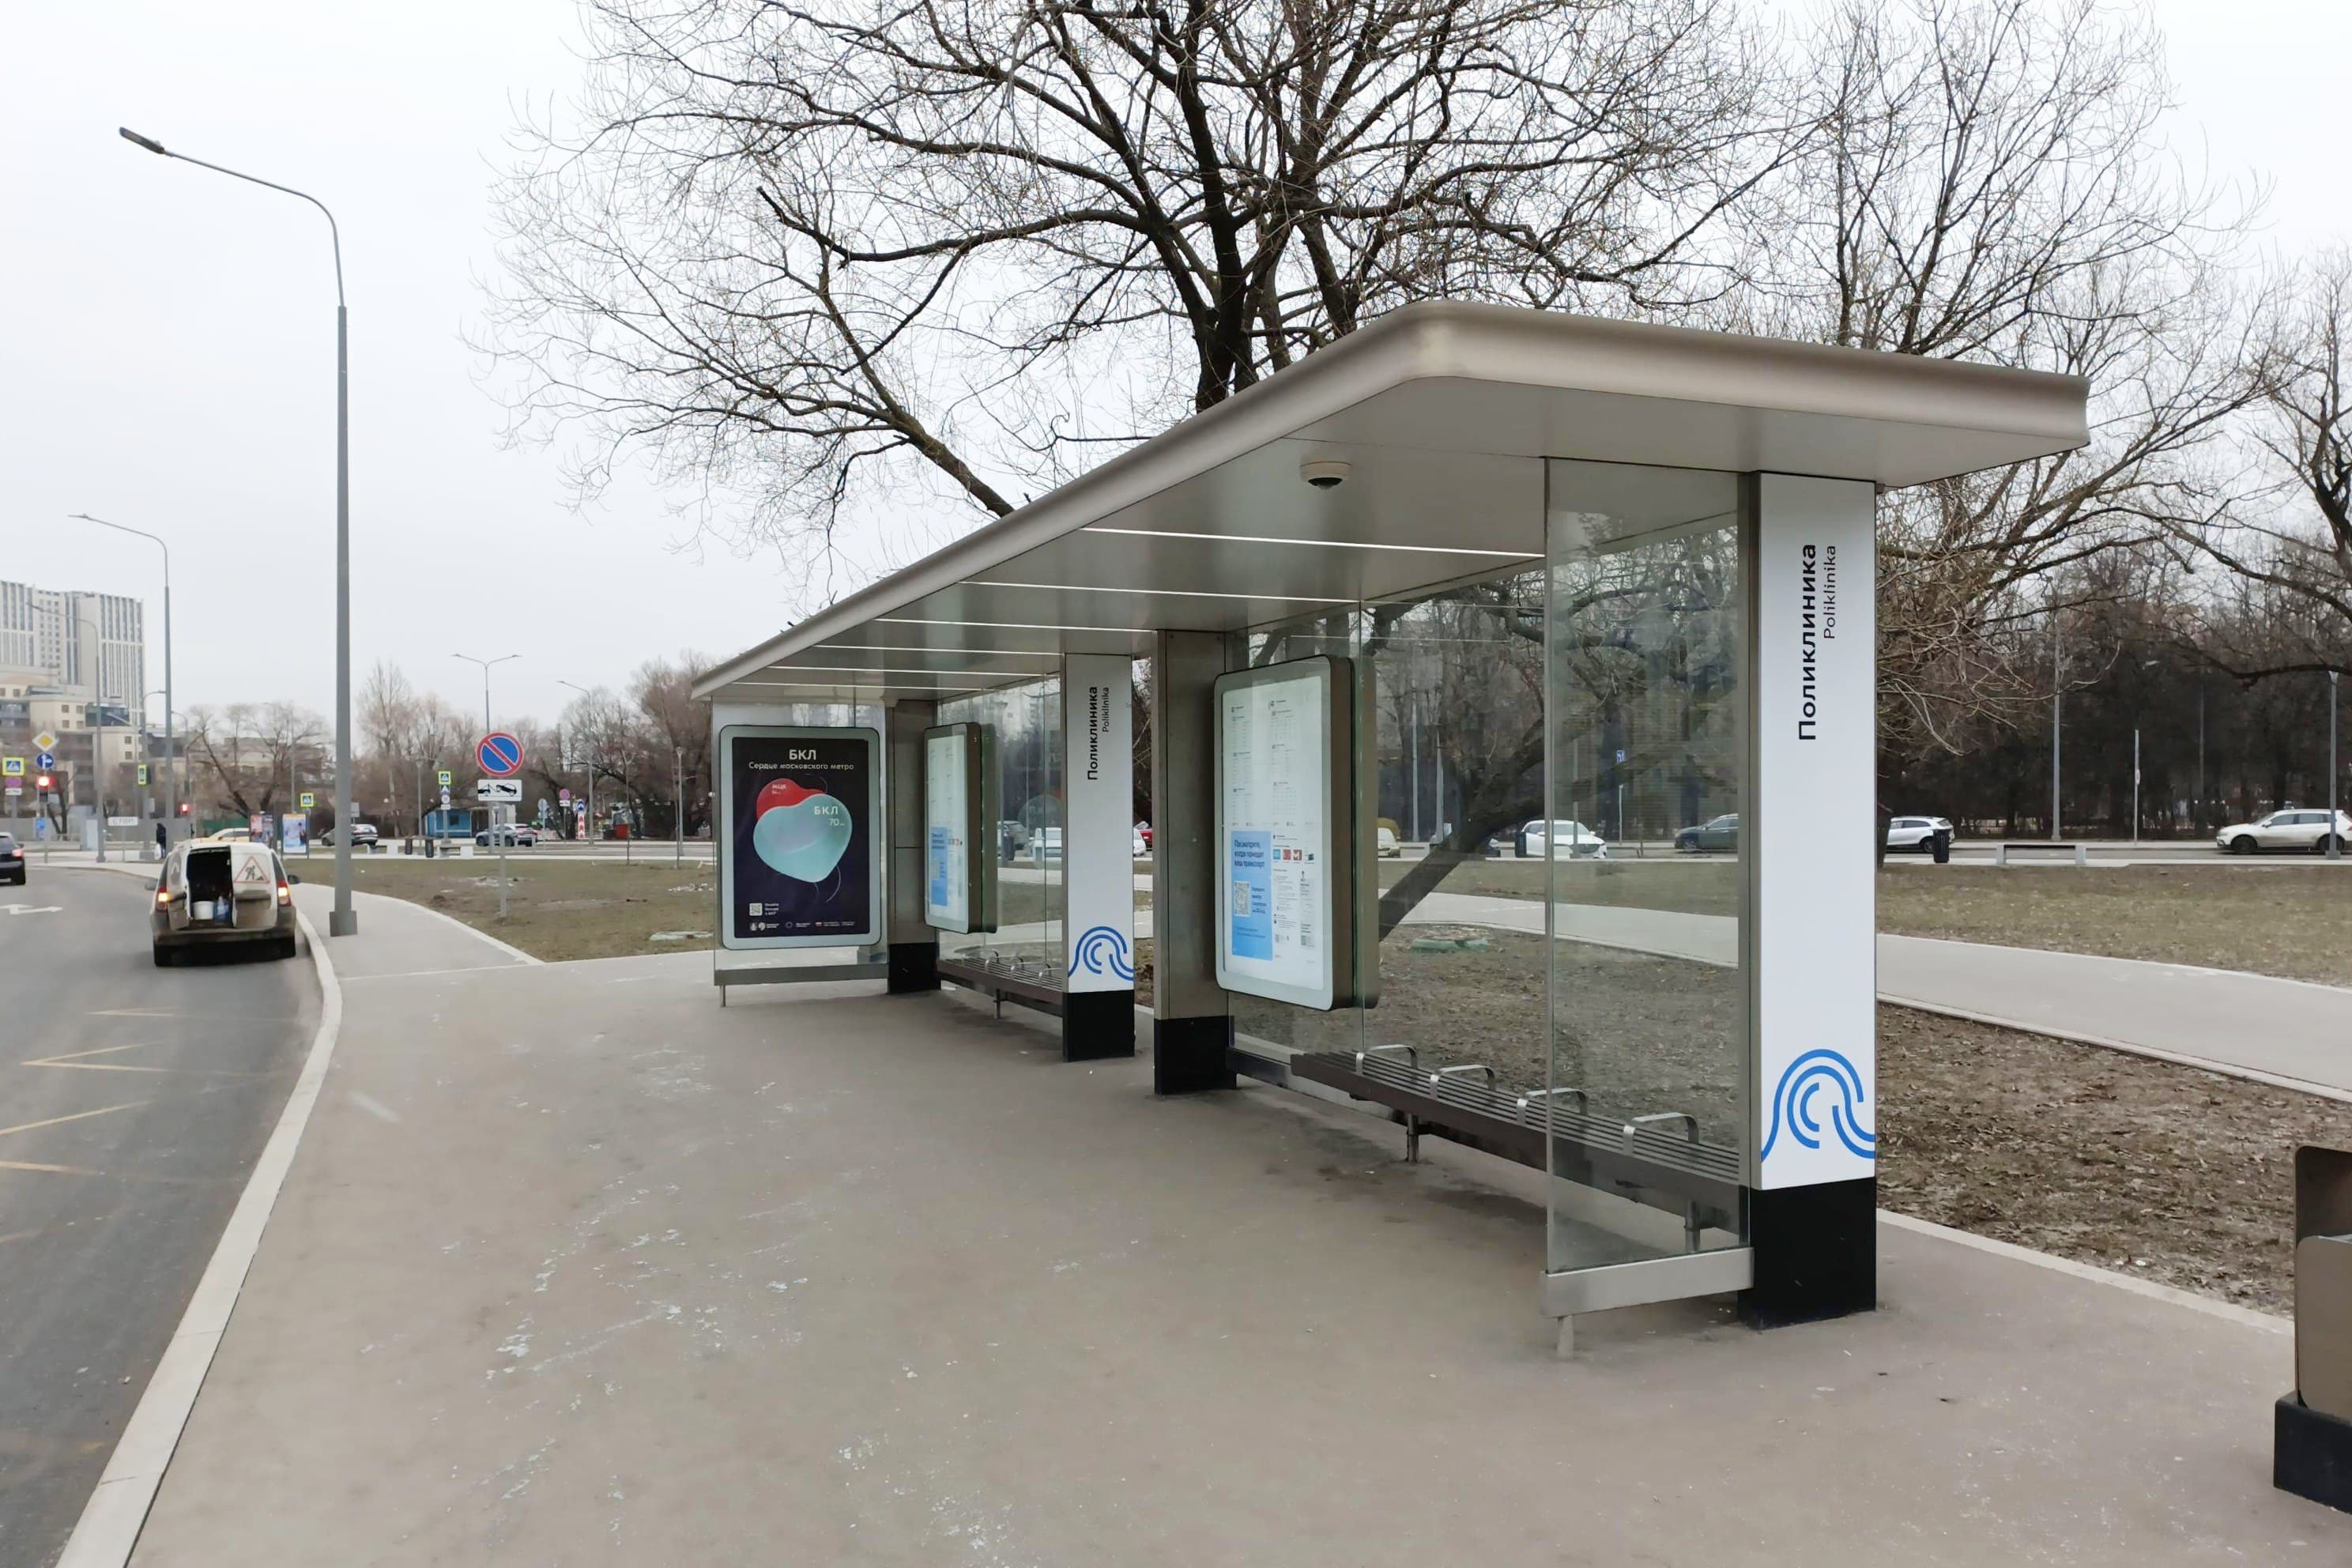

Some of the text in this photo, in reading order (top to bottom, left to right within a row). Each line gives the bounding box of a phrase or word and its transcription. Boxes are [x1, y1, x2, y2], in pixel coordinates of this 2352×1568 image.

[1823, 545, 1836, 639] Poliklinika
[1798, 544, 1816, 741] Поликлиника
[1087, 686, 1099, 780] Поликлиника
[789, 749, 817, 760] БКЛ
[748, 761, 778, 771] Сердце
[813, 805, 839, 815] БКЛ
[829, 818, 839, 827] 70
